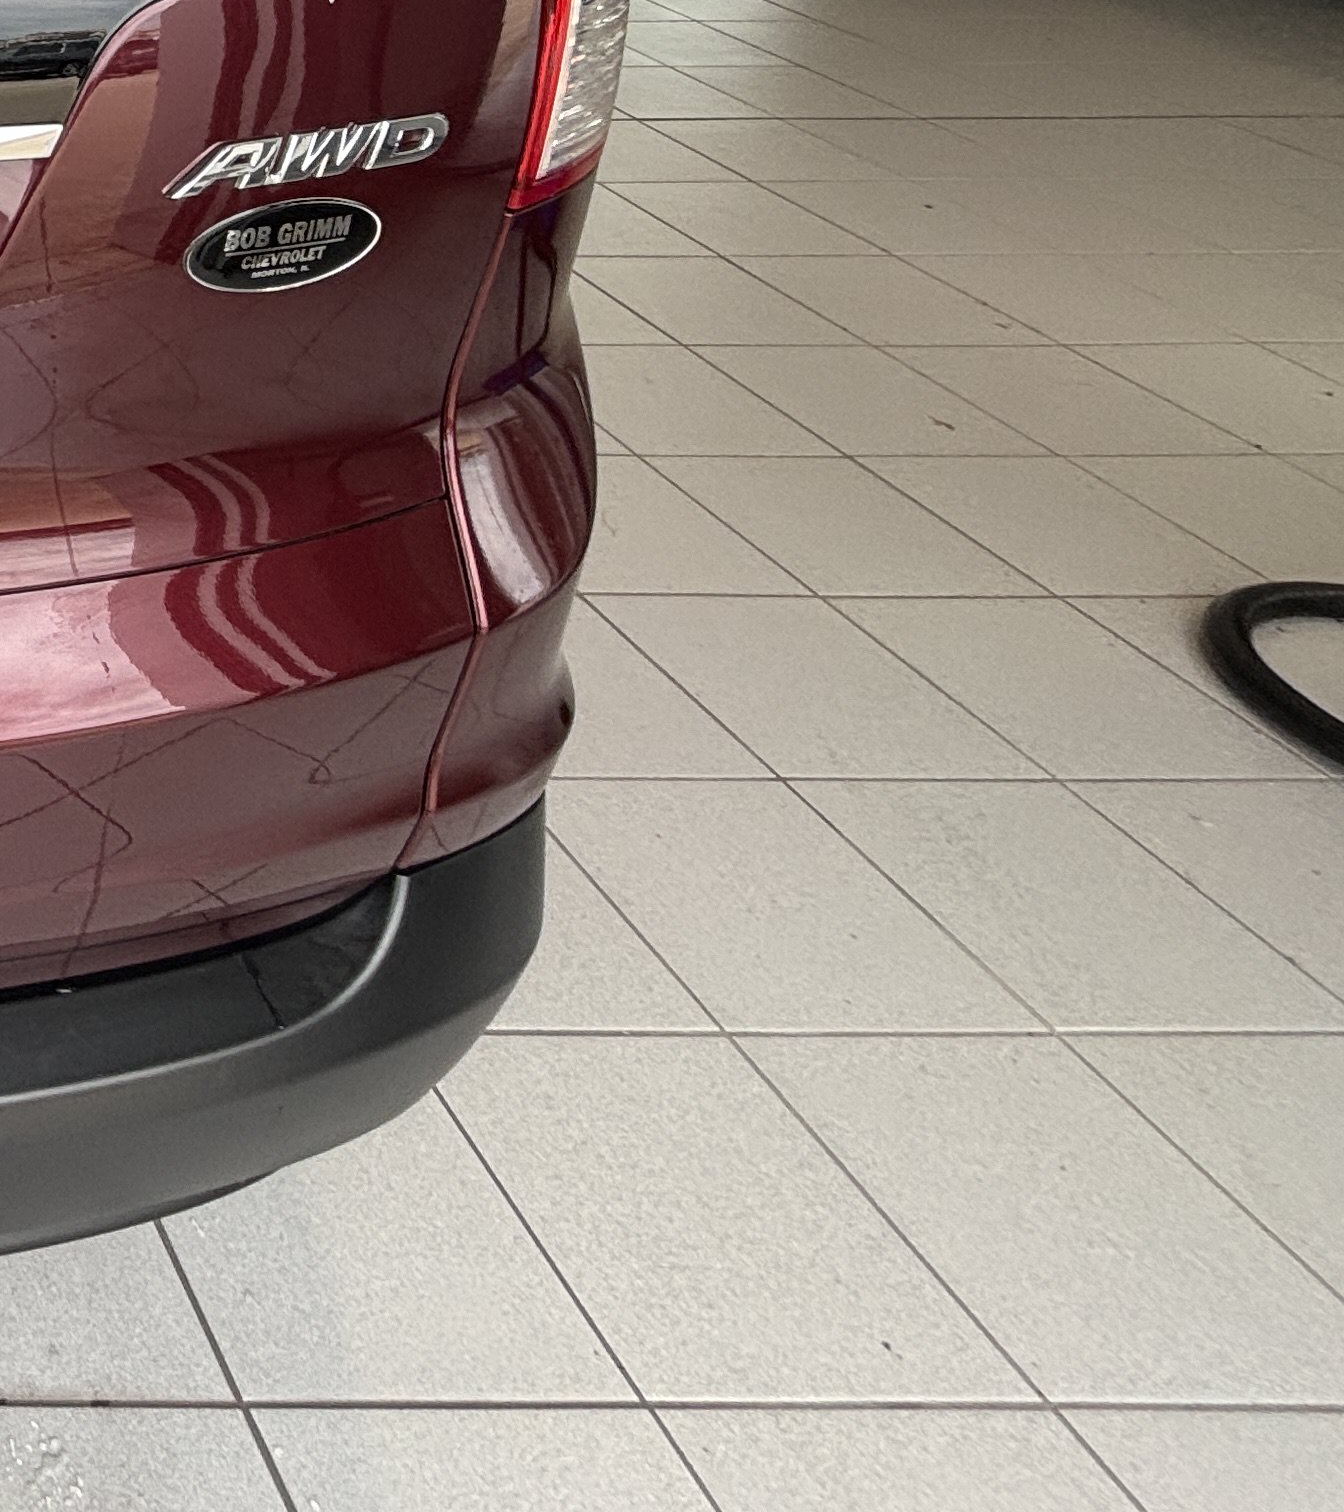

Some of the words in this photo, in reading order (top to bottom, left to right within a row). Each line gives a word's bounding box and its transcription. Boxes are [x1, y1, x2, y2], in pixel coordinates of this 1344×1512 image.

[162, 112, 449, 199] AWD
[224, 226, 272, 252] BOB
[277, 214, 352, 245] GRIMM
[241, 246, 327, 270] CHEVROLET
